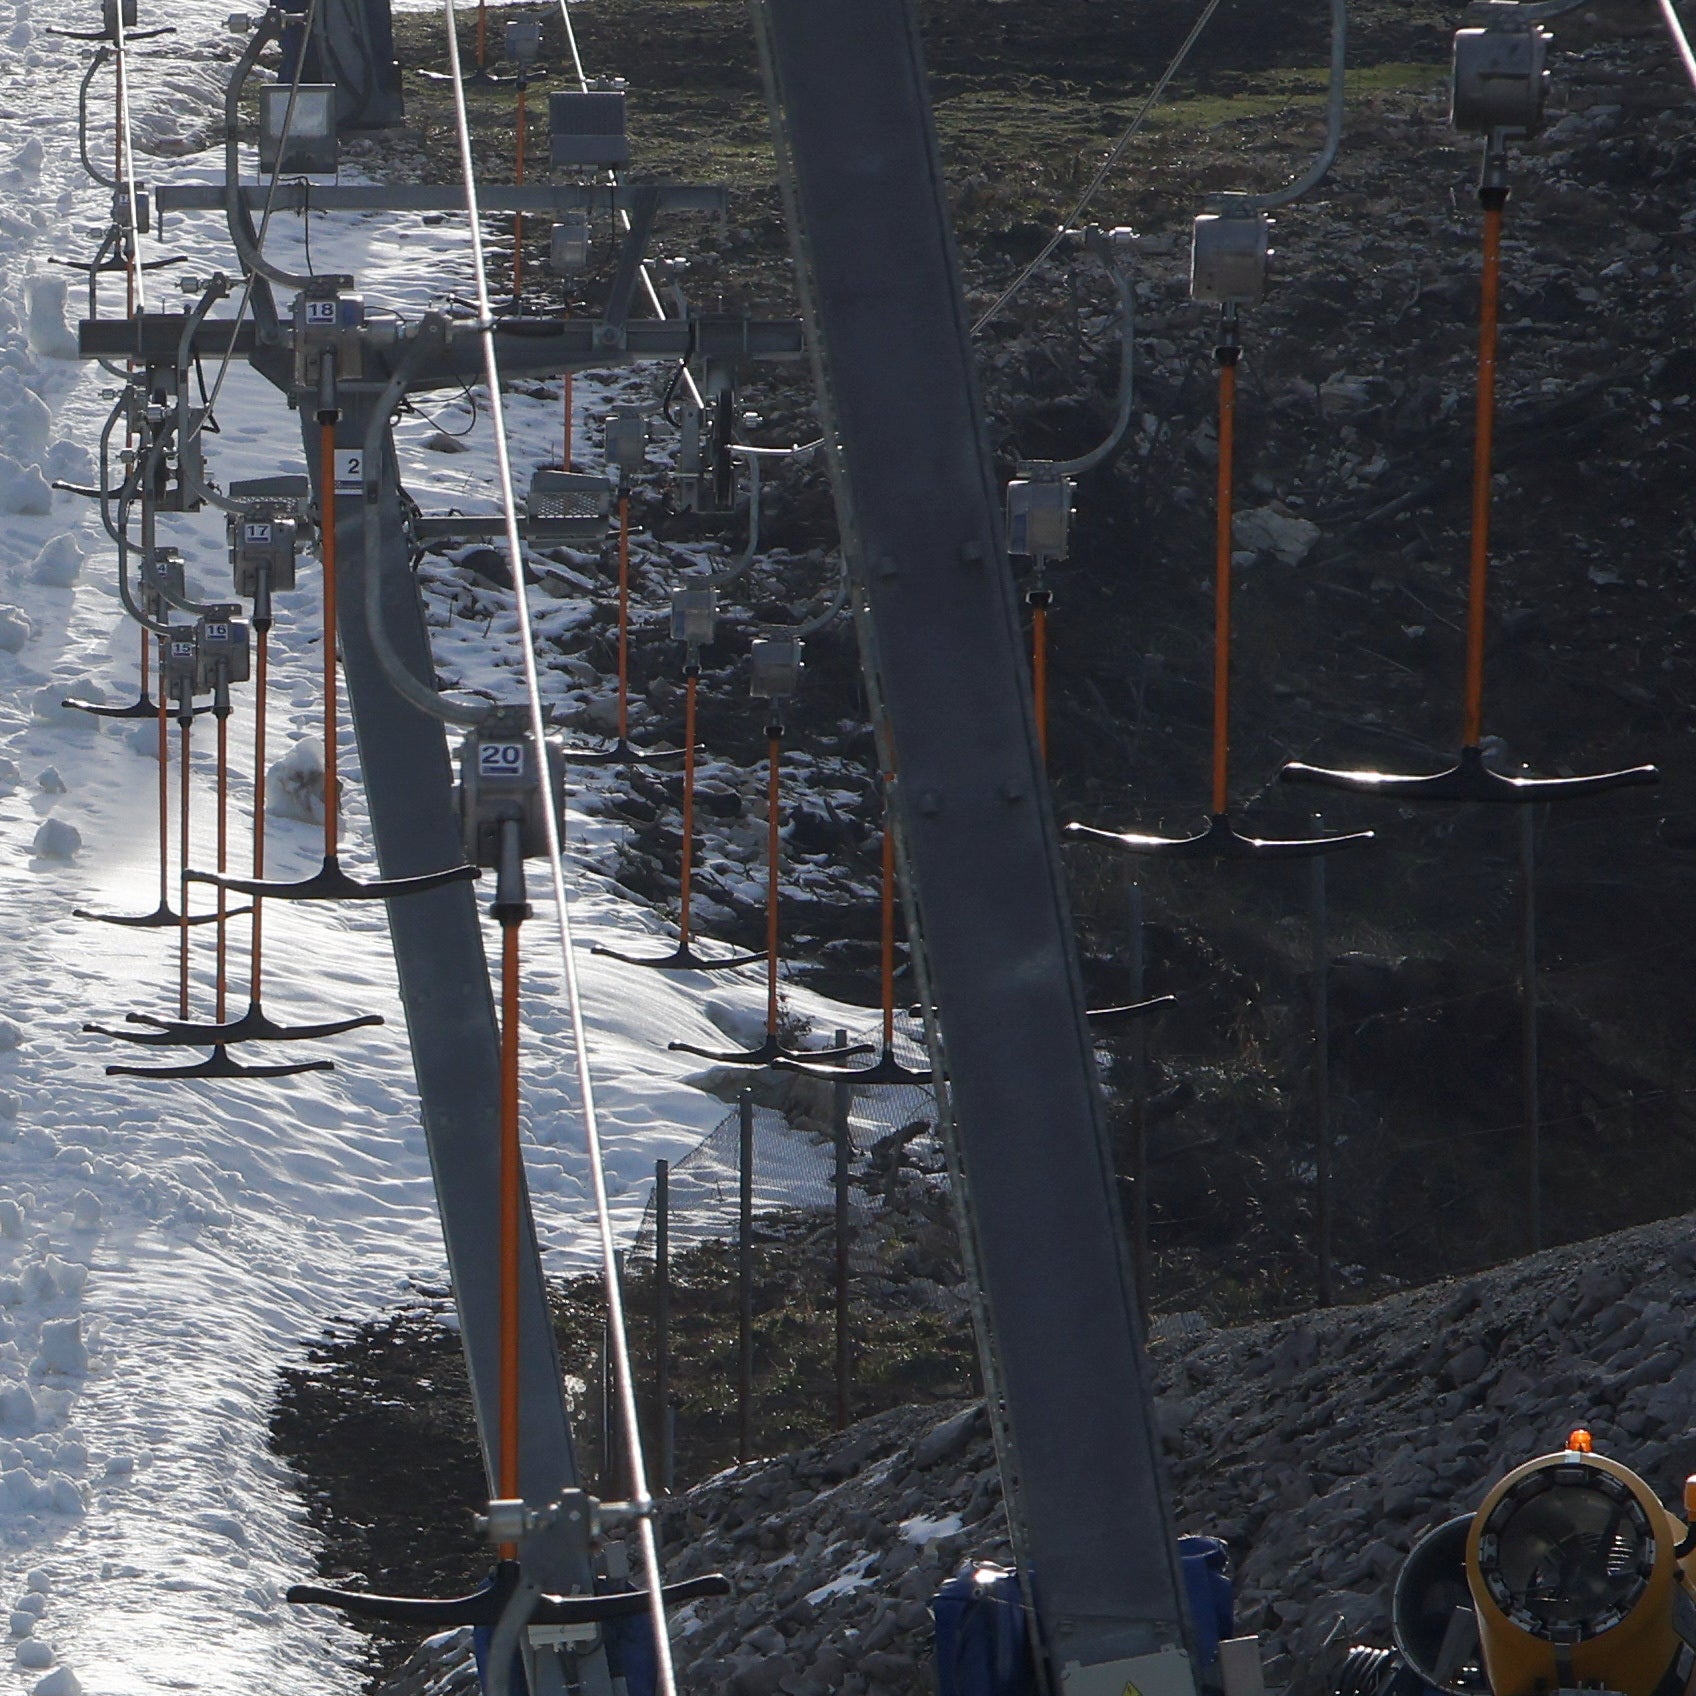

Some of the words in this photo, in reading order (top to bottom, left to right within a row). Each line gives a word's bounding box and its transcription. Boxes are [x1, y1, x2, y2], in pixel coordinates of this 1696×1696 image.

[308, 303, 334, 317] 18
[348, 458, 360, 474] 2
[247, 525, 269, 537] 17
[208, 624, 227, 635] 16
[175, 643, 191, 652] 15
[481, 745, 520, 766] 20
